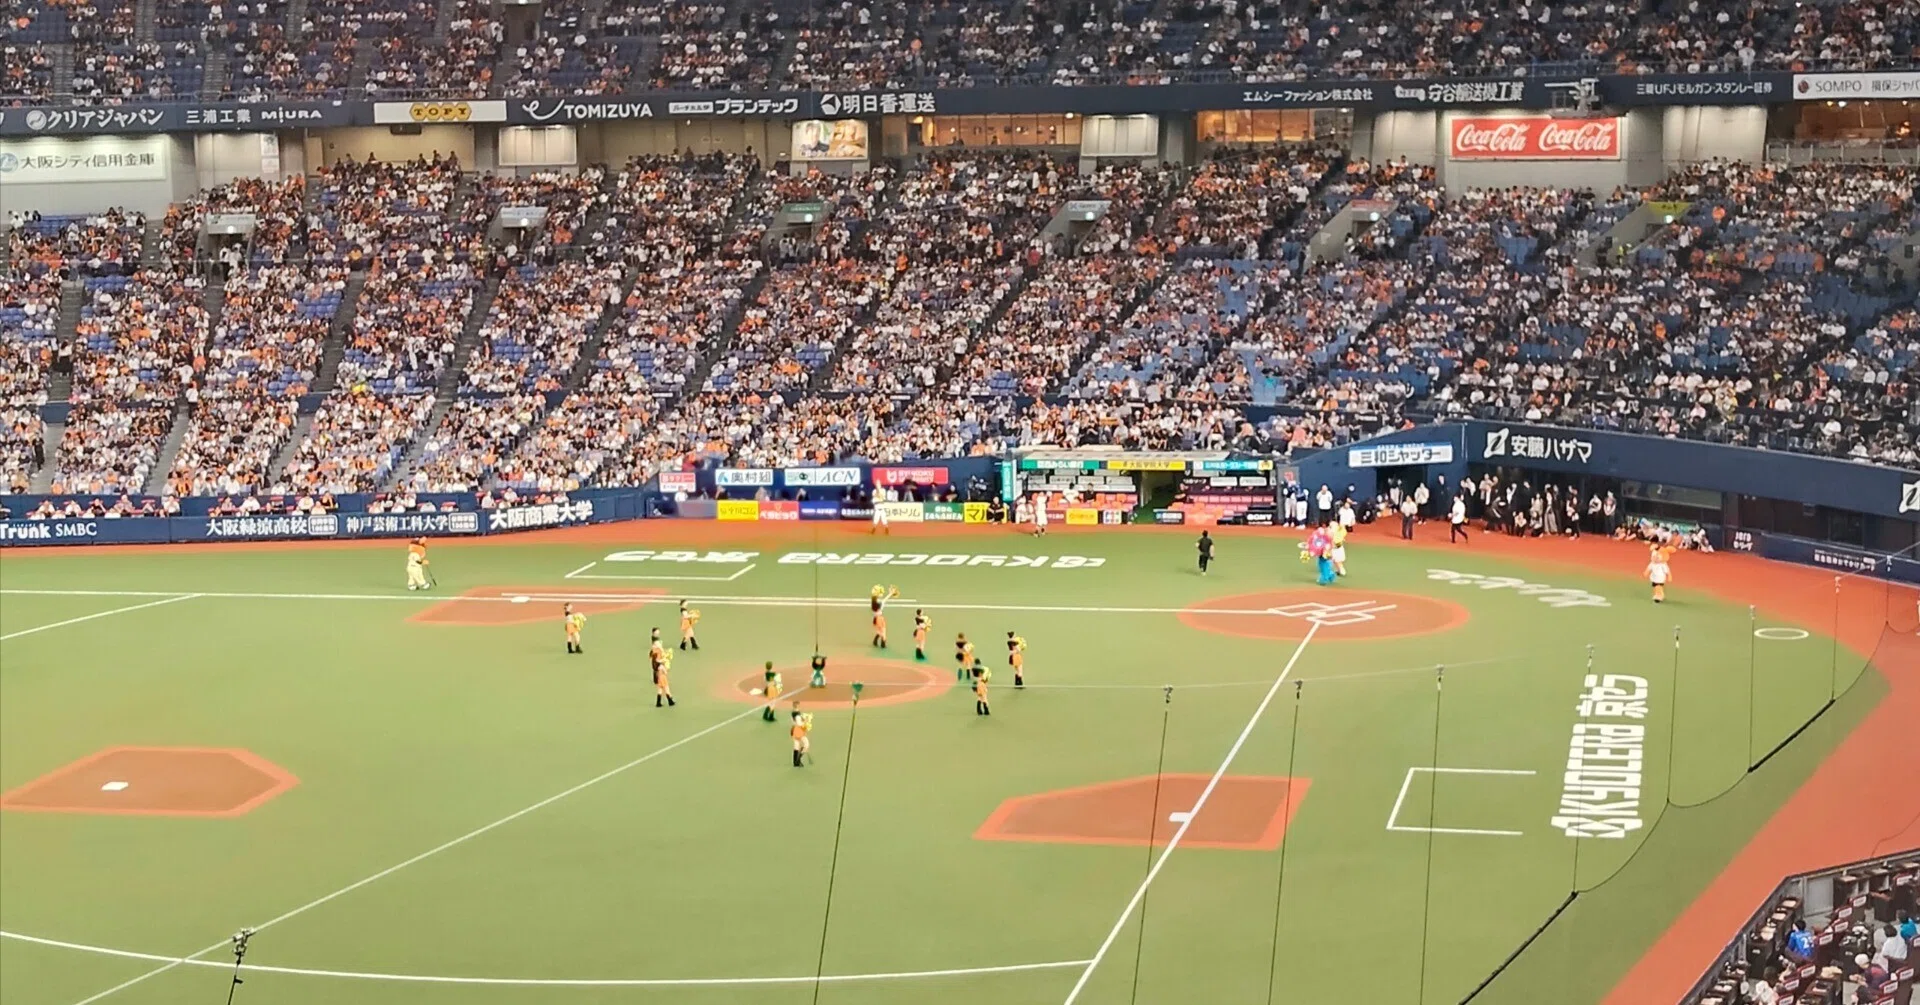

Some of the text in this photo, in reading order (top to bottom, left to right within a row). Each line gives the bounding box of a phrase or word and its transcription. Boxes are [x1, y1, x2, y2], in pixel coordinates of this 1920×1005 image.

[1815, 80, 1862, 92] SOMPO
[1243, 88, 1373, 101] エムシーファッション株式会社
[413, 104, 469, 117] TOPY
[564, 102, 653, 119] TOMIZUYA
[715, 98, 798, 114] プランテック
[842, 93, 936, 114] 明日香運送
[47, 109, 163, 129] クリアジャパン
[186, 109, 250, 124] 三浦工業
[21, 153, 155, 168] 大阪シティ信用金庫
[1361, 448, 1442, 464] 三和シャッター
[1511, 436, 1592, 463] 安藤ハザマ
[489, 500, 594, 530] 大阪商業大学
[55, 522, 98, 537] SMBC
[346, 515, 448, 533] 神戸芸術工科大学
[778, 552, 1050, 568] KYOCERA
[1559, 674, 1648, 817] KYOCERA 京セラ
